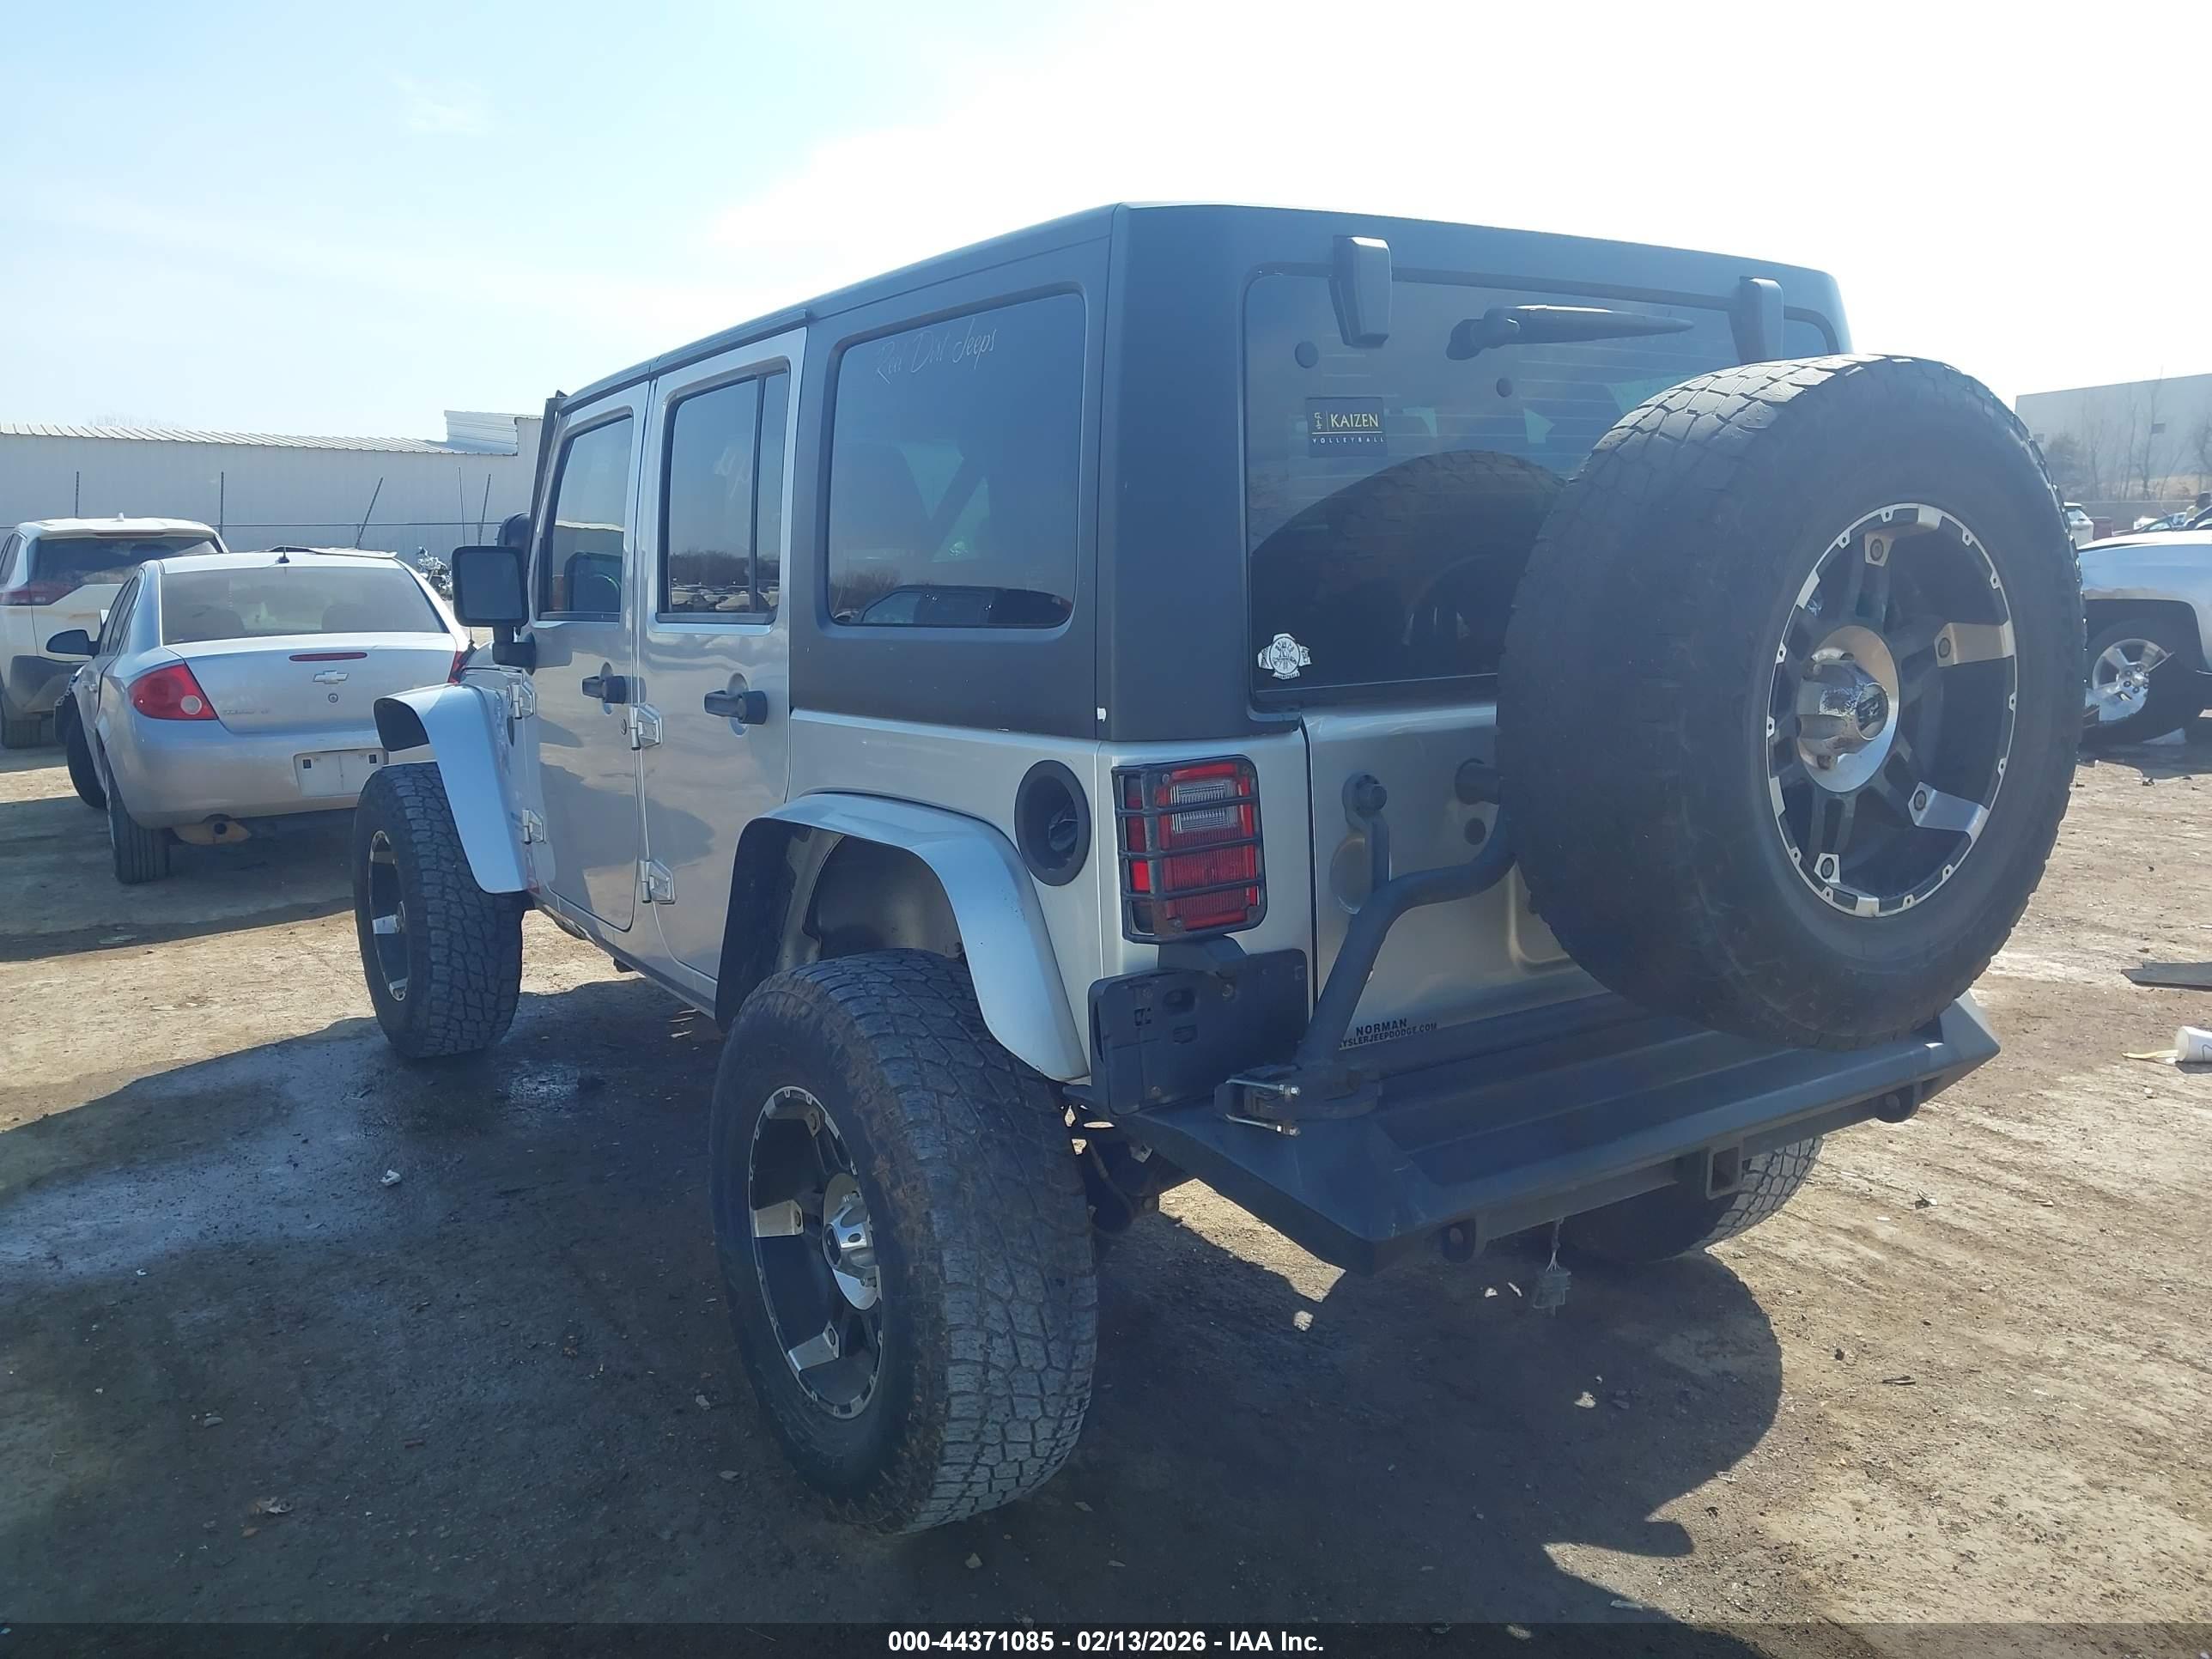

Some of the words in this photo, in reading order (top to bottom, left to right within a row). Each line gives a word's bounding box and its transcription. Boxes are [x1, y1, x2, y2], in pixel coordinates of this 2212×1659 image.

[952, 318, 996, 369] Jeeps
[1331, 413, 1379, 428] KAIZEN
[1312, 436, 1385, 445] VOLLEYBALL
[1356, 1018, 1407, 1036] NORMAN
